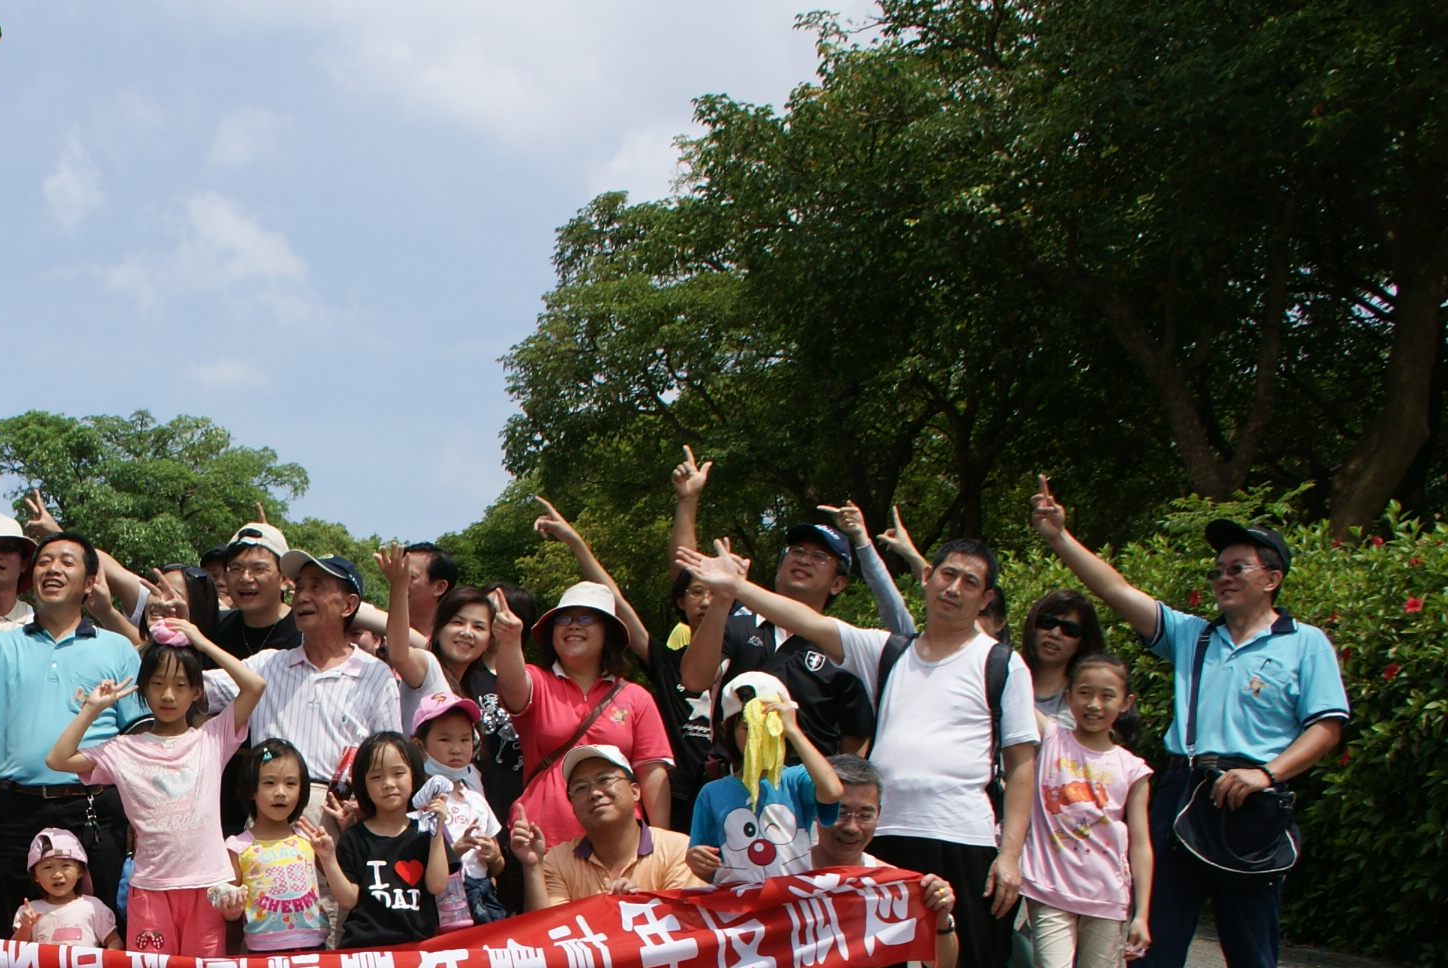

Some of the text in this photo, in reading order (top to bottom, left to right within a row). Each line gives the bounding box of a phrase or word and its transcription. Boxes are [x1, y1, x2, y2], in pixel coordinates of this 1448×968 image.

[265, 863, 307, 896] 39
[366, 860, 390, 890] I
[255, 888, 318, 914] CHERRY
